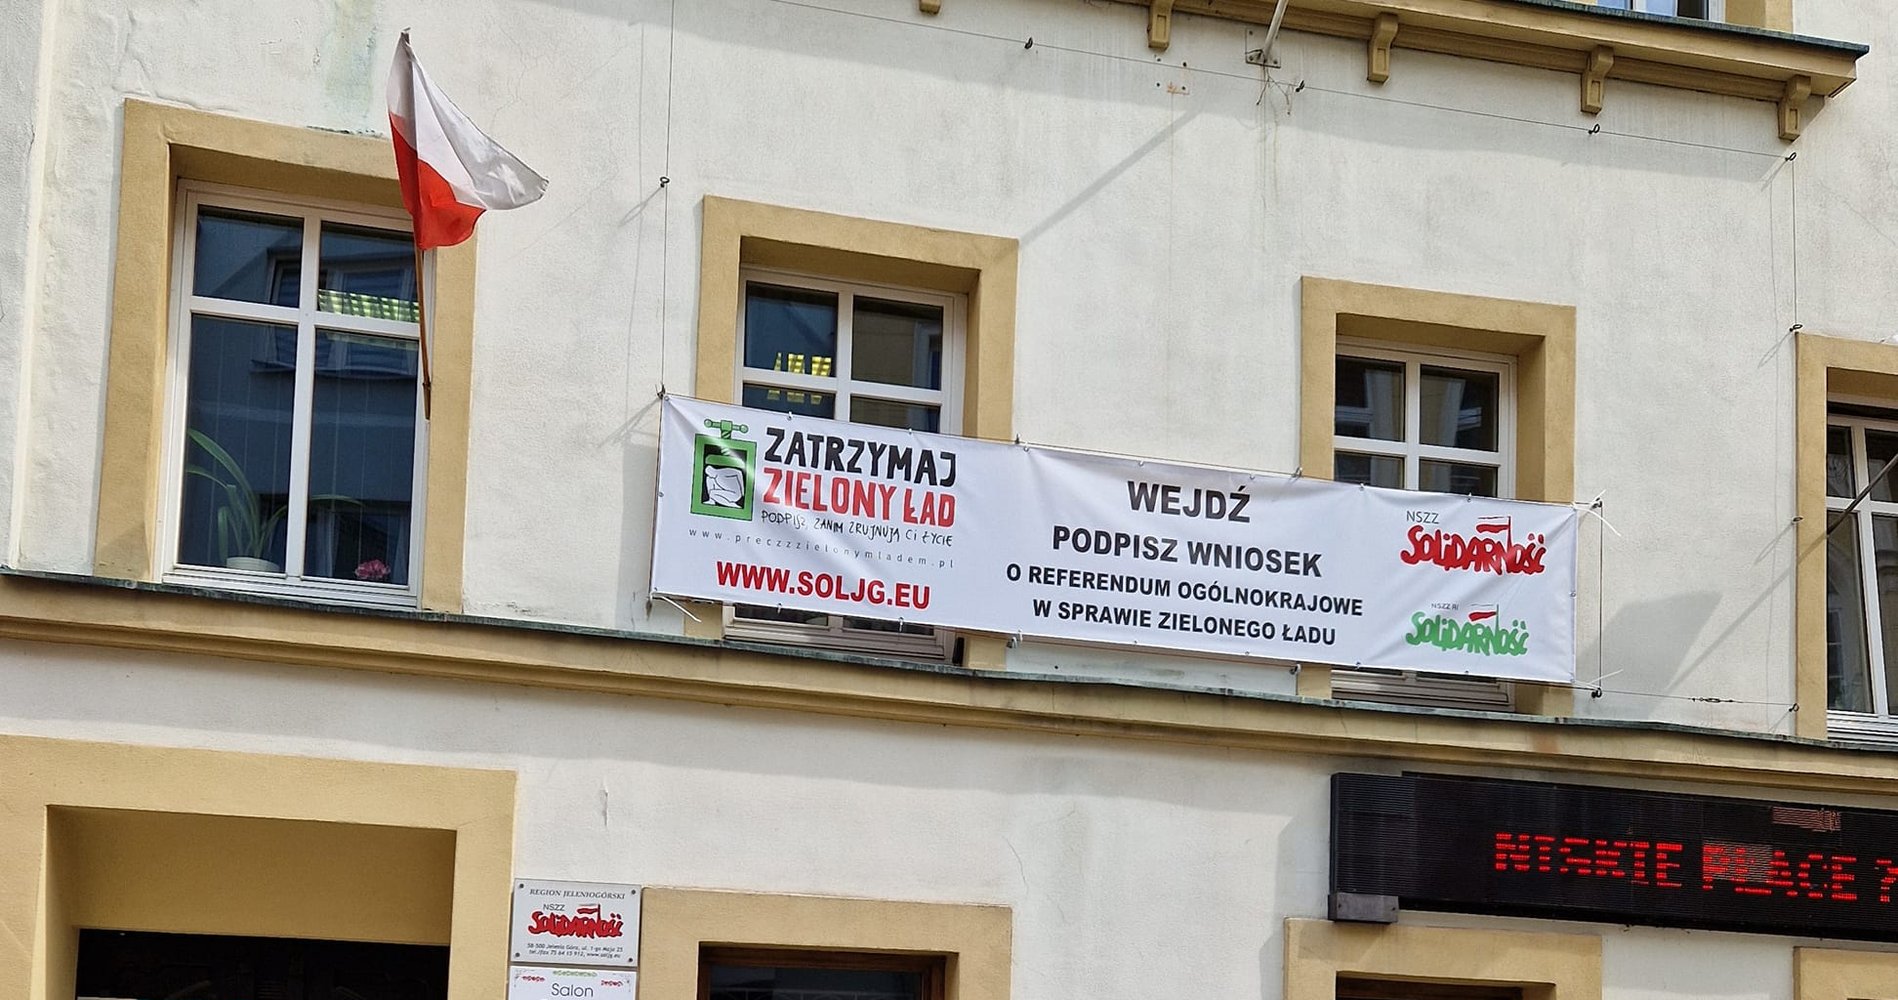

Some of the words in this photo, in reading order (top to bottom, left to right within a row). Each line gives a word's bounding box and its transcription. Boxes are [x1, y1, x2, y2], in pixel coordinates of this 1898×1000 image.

[764, 427, 957, 487] ZATRZYMAJ
[762, 467, 897, 521] ZIELONY
[903, 488, 955, 527] ŁAD
[1127, 481, 1250, 523] WEJDŹ
[1406, 510, 1440, 524] NSZZ
[814, 517, 844, 534] ZANIM
[849, 522, 900, 543] ZRUJNUJĄ
[922, 531, 953, 547] ŻYCIE
[1053, 525, 1178, 562] PODPISZ
[1188, 541, 1322, 577] WNIOSEK
[716, 561, 930, 610] WWW.SOLJG.EU
[1006, 563, 1021, 581] O
[1029, 565, 1170, 597] REFERENDUM
[1178, 580, 1363, 616] OGÓLNOKRAJOWE
[1032, 599, 1052, 618] W
[1058, 601, 1152, 628] SPRAWIE
[1158, 612, 1275, 640] ZIELONEGO
[1282, 623, 1336, 645] ŁADU
[543, 903, 565, 911] NSZZ
[563, 890, 625, 900] JELENIOGÓRSKI
[551, 983, 593, 997] Salon
